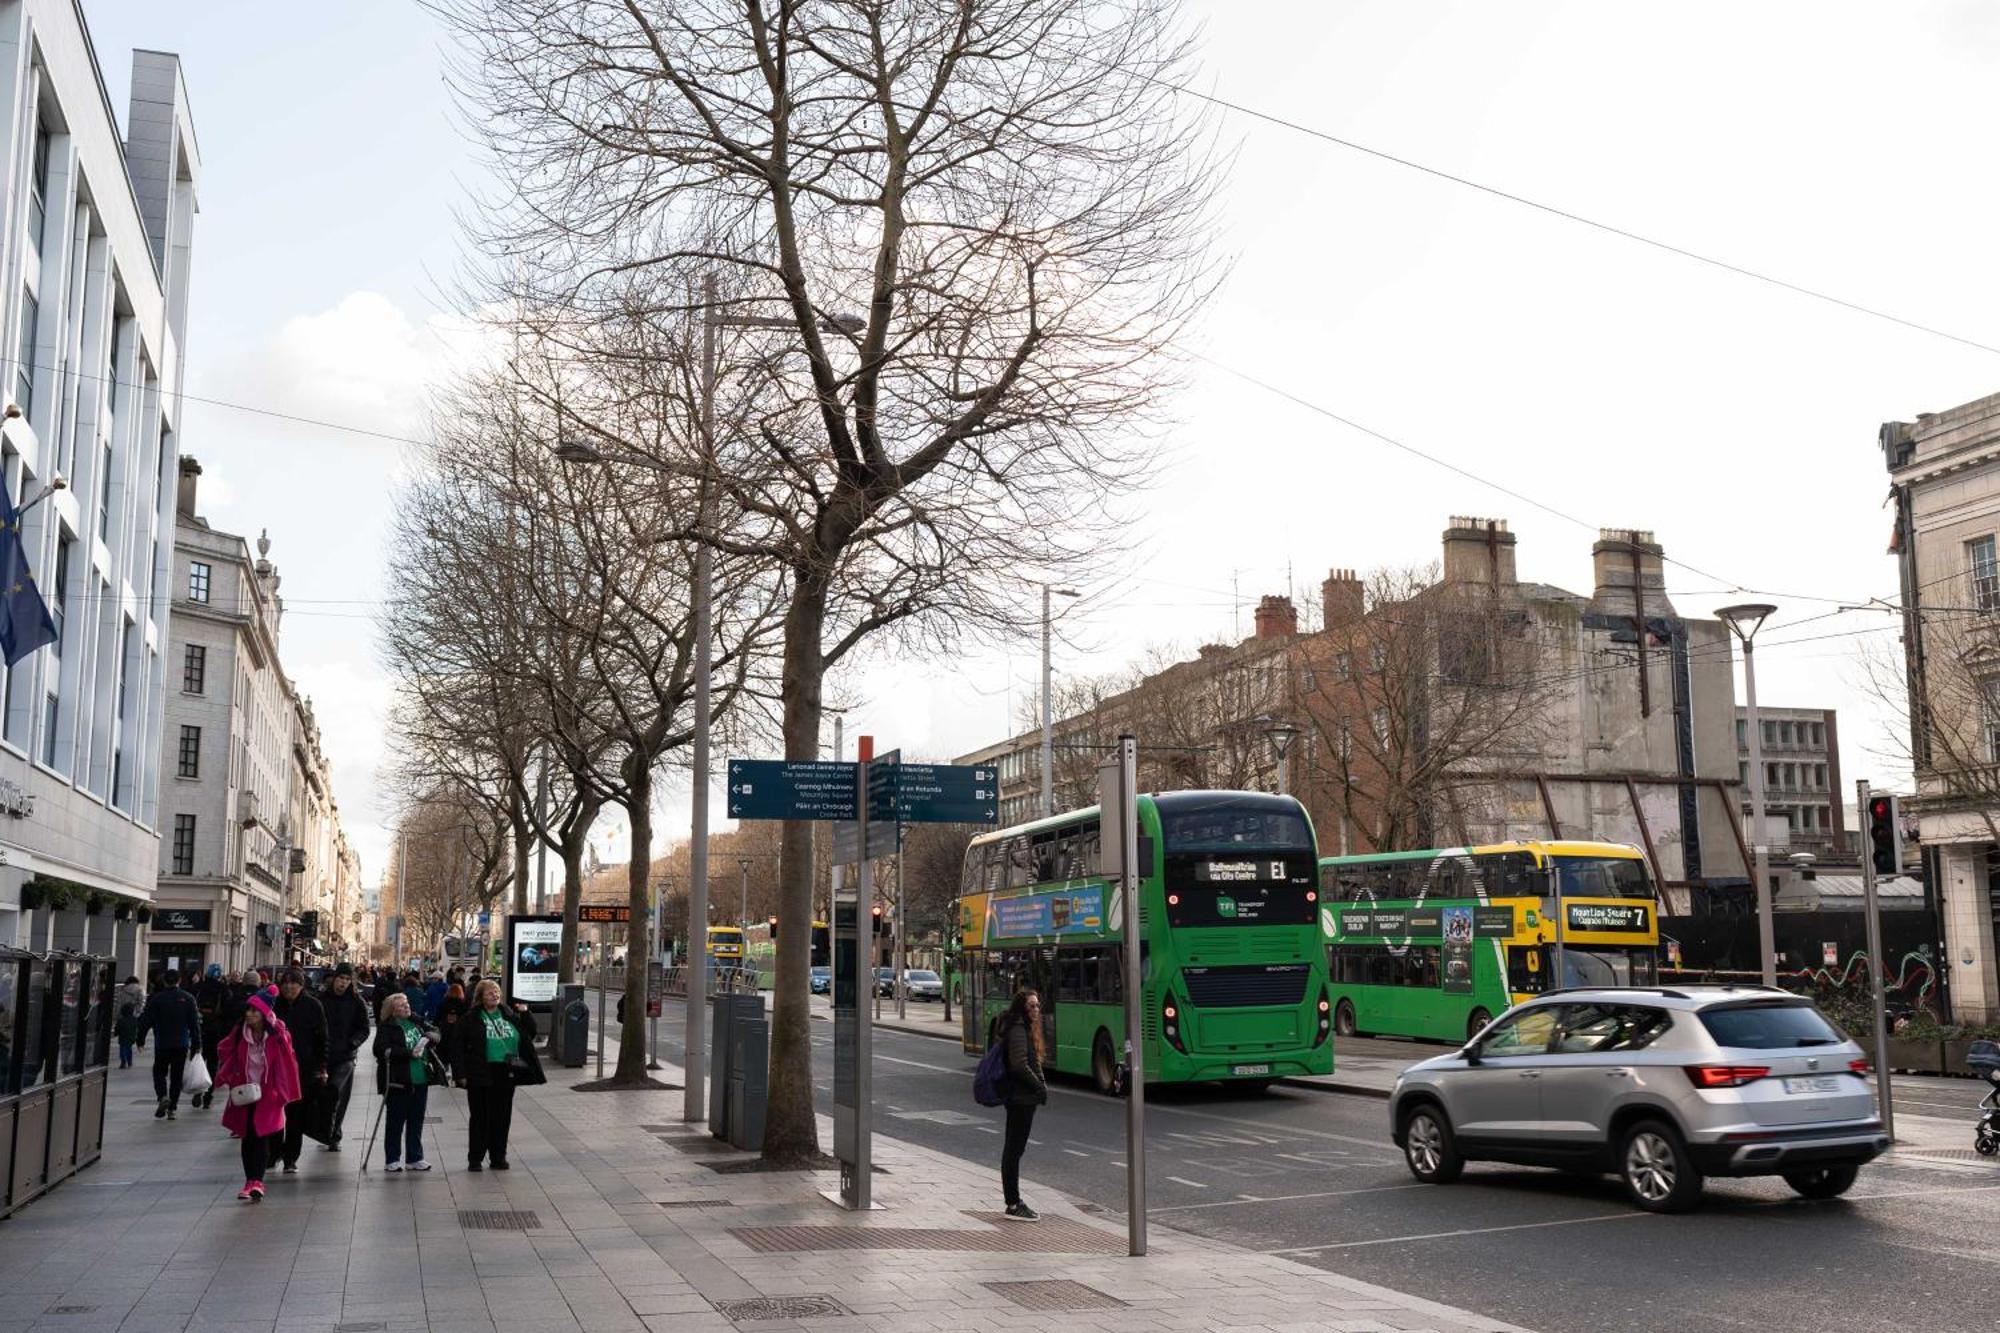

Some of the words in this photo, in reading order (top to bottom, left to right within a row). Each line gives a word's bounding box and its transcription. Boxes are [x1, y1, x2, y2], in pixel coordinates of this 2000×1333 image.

[1210, 872, 1221, 880] via
[1221, 871, 1234, 881] City
[1235, 871, 1257, 880] Centre
[1270, 861, 1286, 880] E1
[1218, 902, 1235, 910] TFI
[1607, 908, 1632, 918] Square
[1634, 909, 1644, 926] 7
